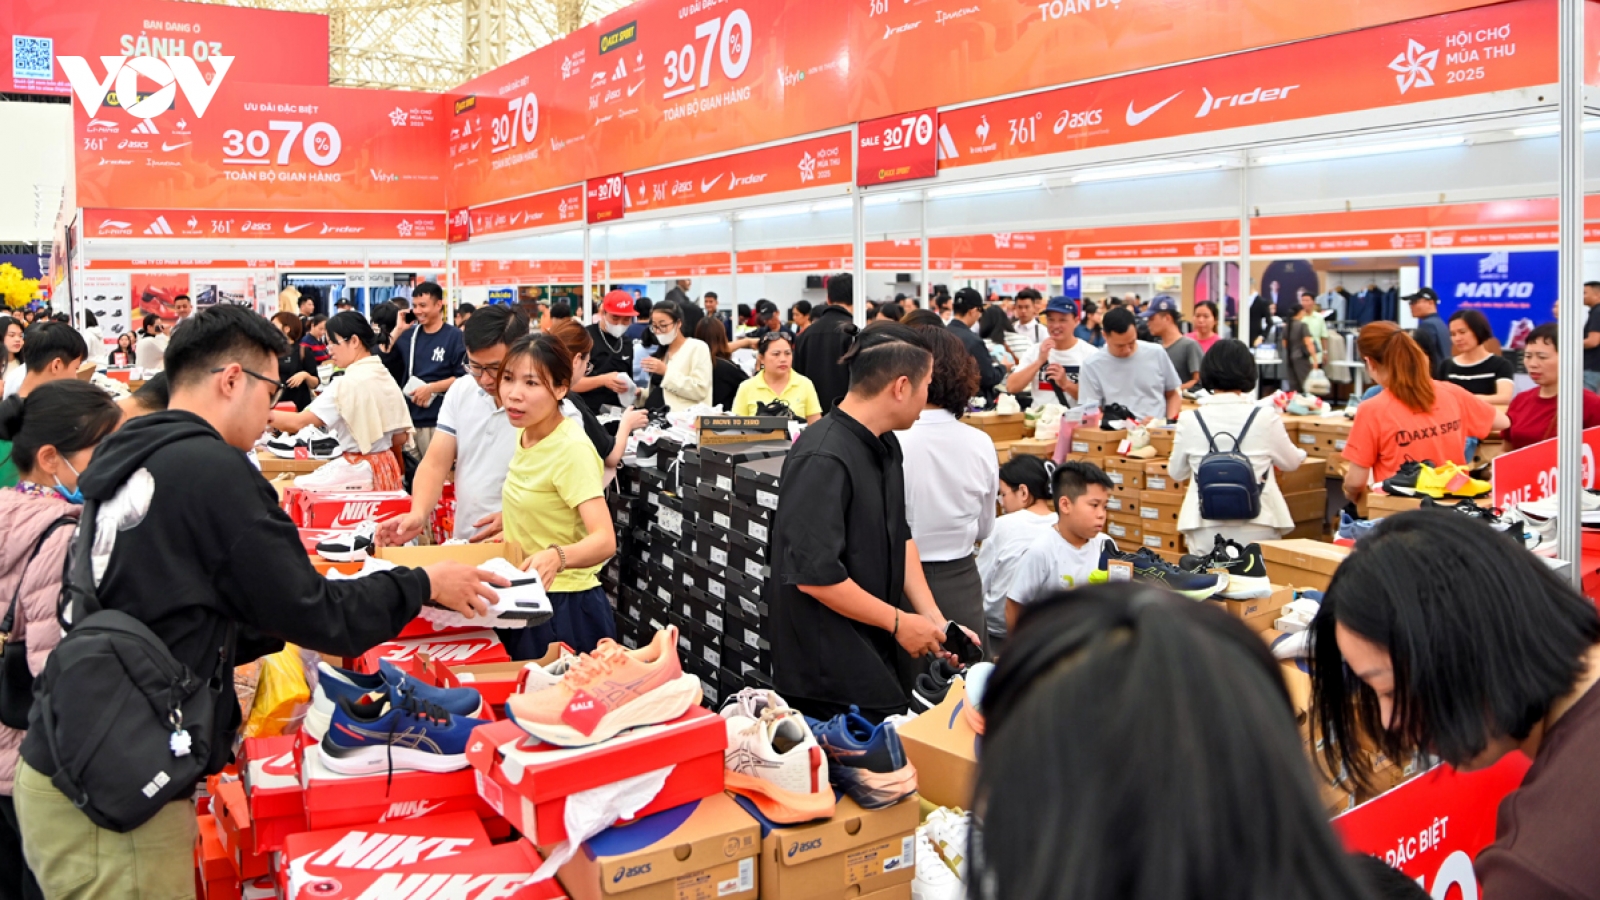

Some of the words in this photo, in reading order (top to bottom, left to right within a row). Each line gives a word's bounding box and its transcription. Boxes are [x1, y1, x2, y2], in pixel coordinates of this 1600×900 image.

[1446, 30, 1472, 49] HỘI
[1475, 23, 1511, 43] CHỢ
[1446, 48, 1480, 66] MÙA
[1484, 43, 1516, 59] THU
[1446, 67, 1486, 85] 2025
[699, 97, 722, 112] GIAN
[723, 86, 751, 106] HÀNG
[1211, 84, 1300, 110] rider
[298, 103, 319, 115] BIỆT
[1069, 108, 1103, 128] asics
[128, 140, 149, 149] asics
[861, 135, 880, 147] SALE
[223, 170, 257, 181] TOÀN
[258, 170, 276, 183] BỘ
[278, 171, 307, 182] GIAN
[308, 170, 341, 182] HÀNG
[735, 173, 768, 186] rider
[326, 225, 366, 233] rider
[1454, 282, 1534, 298] MAY10
[339, 500, 382, 520] NIKE
[570, 700, 594, 711] SALE
[386, 800, 431, 818] NIKE
[1419, 816, 1449, 850] BIỆT
[311, 830, 475, 870] NIKE
[799, 839, 822, 852] asics
[626, 864, 652, 878] asics
